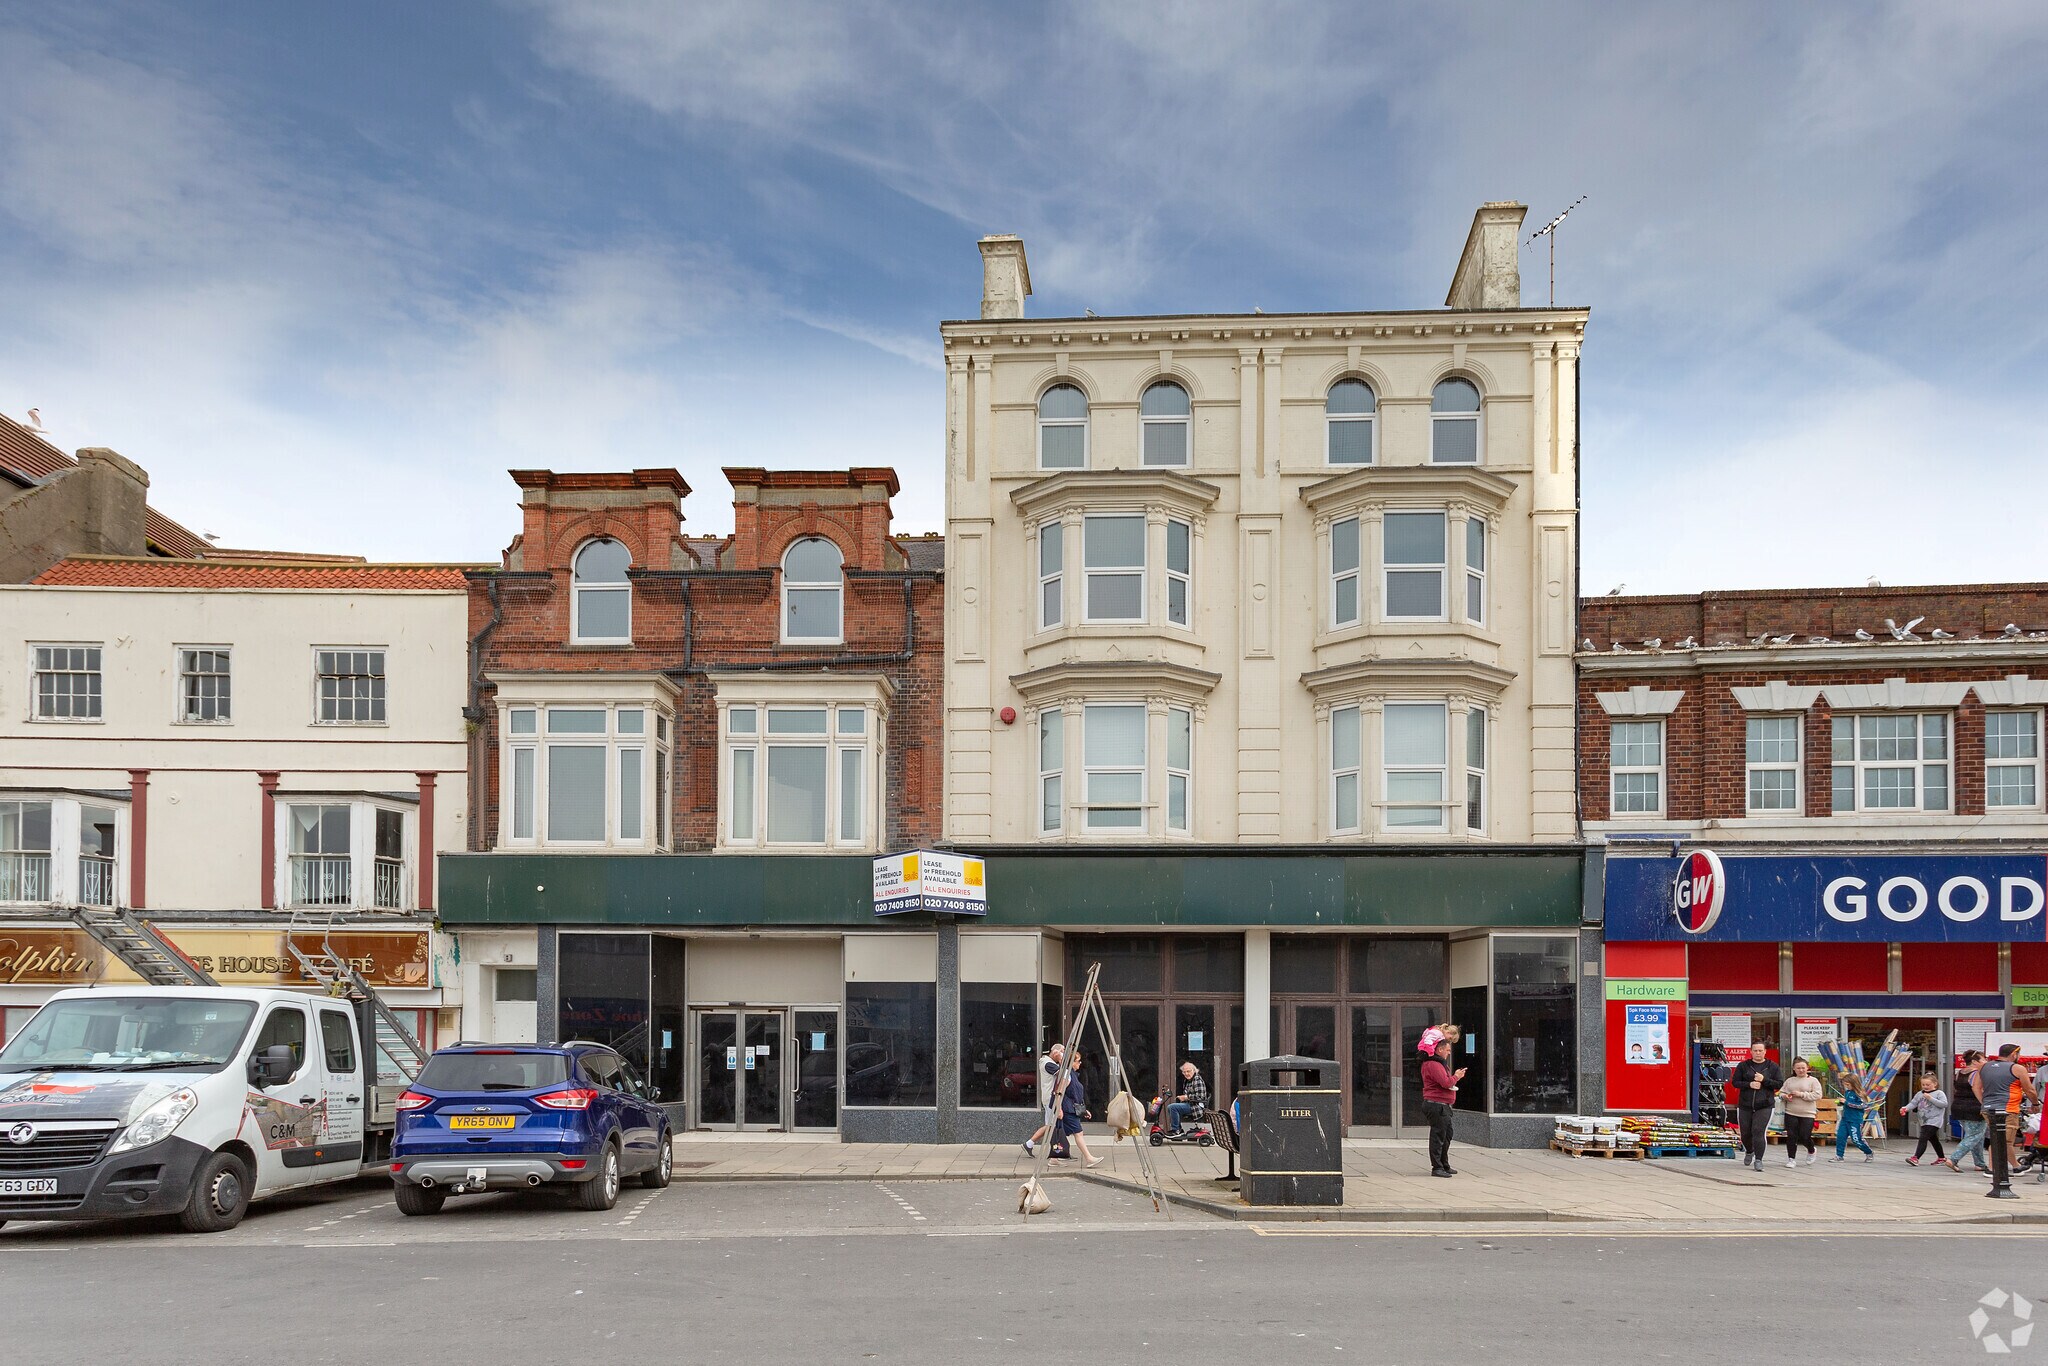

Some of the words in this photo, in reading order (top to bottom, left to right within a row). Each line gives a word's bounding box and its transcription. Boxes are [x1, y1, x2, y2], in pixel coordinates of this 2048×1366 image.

[881, 871, 902, 880] FREEHOLD
[903, 872, 918, 881] savills
[931, 870, 962, 878] FREEHOLD
[875, 879, 898, 887] AVAILABLE
[924, 876, 957, 884] AVAILABLE
[964, 877, 982, 886] savills
[885, 887, 909, 896] ENQUIRIES
[938, 888, 971, 896] ENQUIRIES
[1677, 874, 1713, 909] GW
[1823, 876, 2045, 922] GOOD
[875, 903, 887, 912] 020
[888, 901, 904, 910] 7409
[905, 898, 920, 908] 8150
[924, 898, 941, 907] 020
[943, 900, 964, 910] 7409
[966, 902, 984, 911] 8150
[218, 956, 293, 973] HOUSE
[1616, 985, 1675, 996] Hardware
[1633, 1014, 1659, 1022] £3.99
[1281, 1109, 1312, 1117] LITTER
[456, 1116, 485, 1126] YR65
[488, 1116, 510, 1126] ONV
[270, 1123, 296, 1139] C&M
[26, 1180, 55, 1191] GDX
